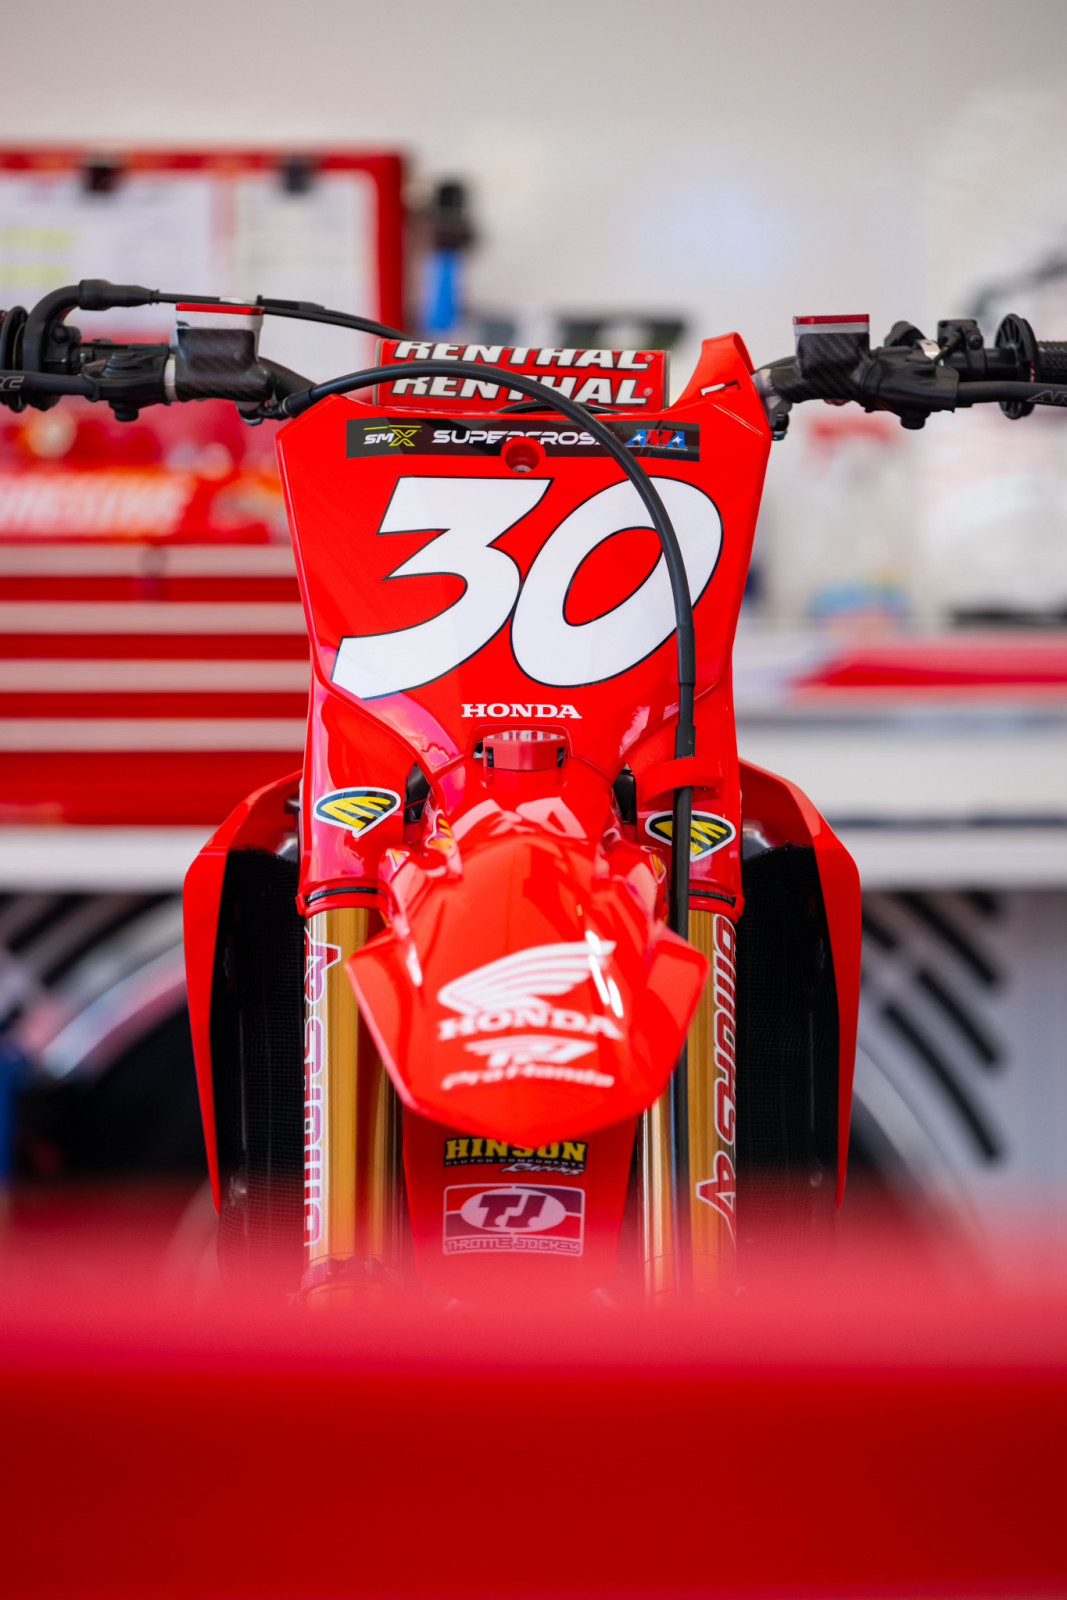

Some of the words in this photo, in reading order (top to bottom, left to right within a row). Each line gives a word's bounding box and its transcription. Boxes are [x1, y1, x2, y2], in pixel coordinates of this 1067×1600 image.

[394, 341, 649, 369] RENTHAL
[363, 428, 418, 447] SMX
[431, 429, 600, 446] SUPEROS
[624, 429, 688, 448] AMA
[331, 475, 724, 700] 30
[461, 702, 583, 719] HONDA
[438, 1007, 624, 1041] HONDA
